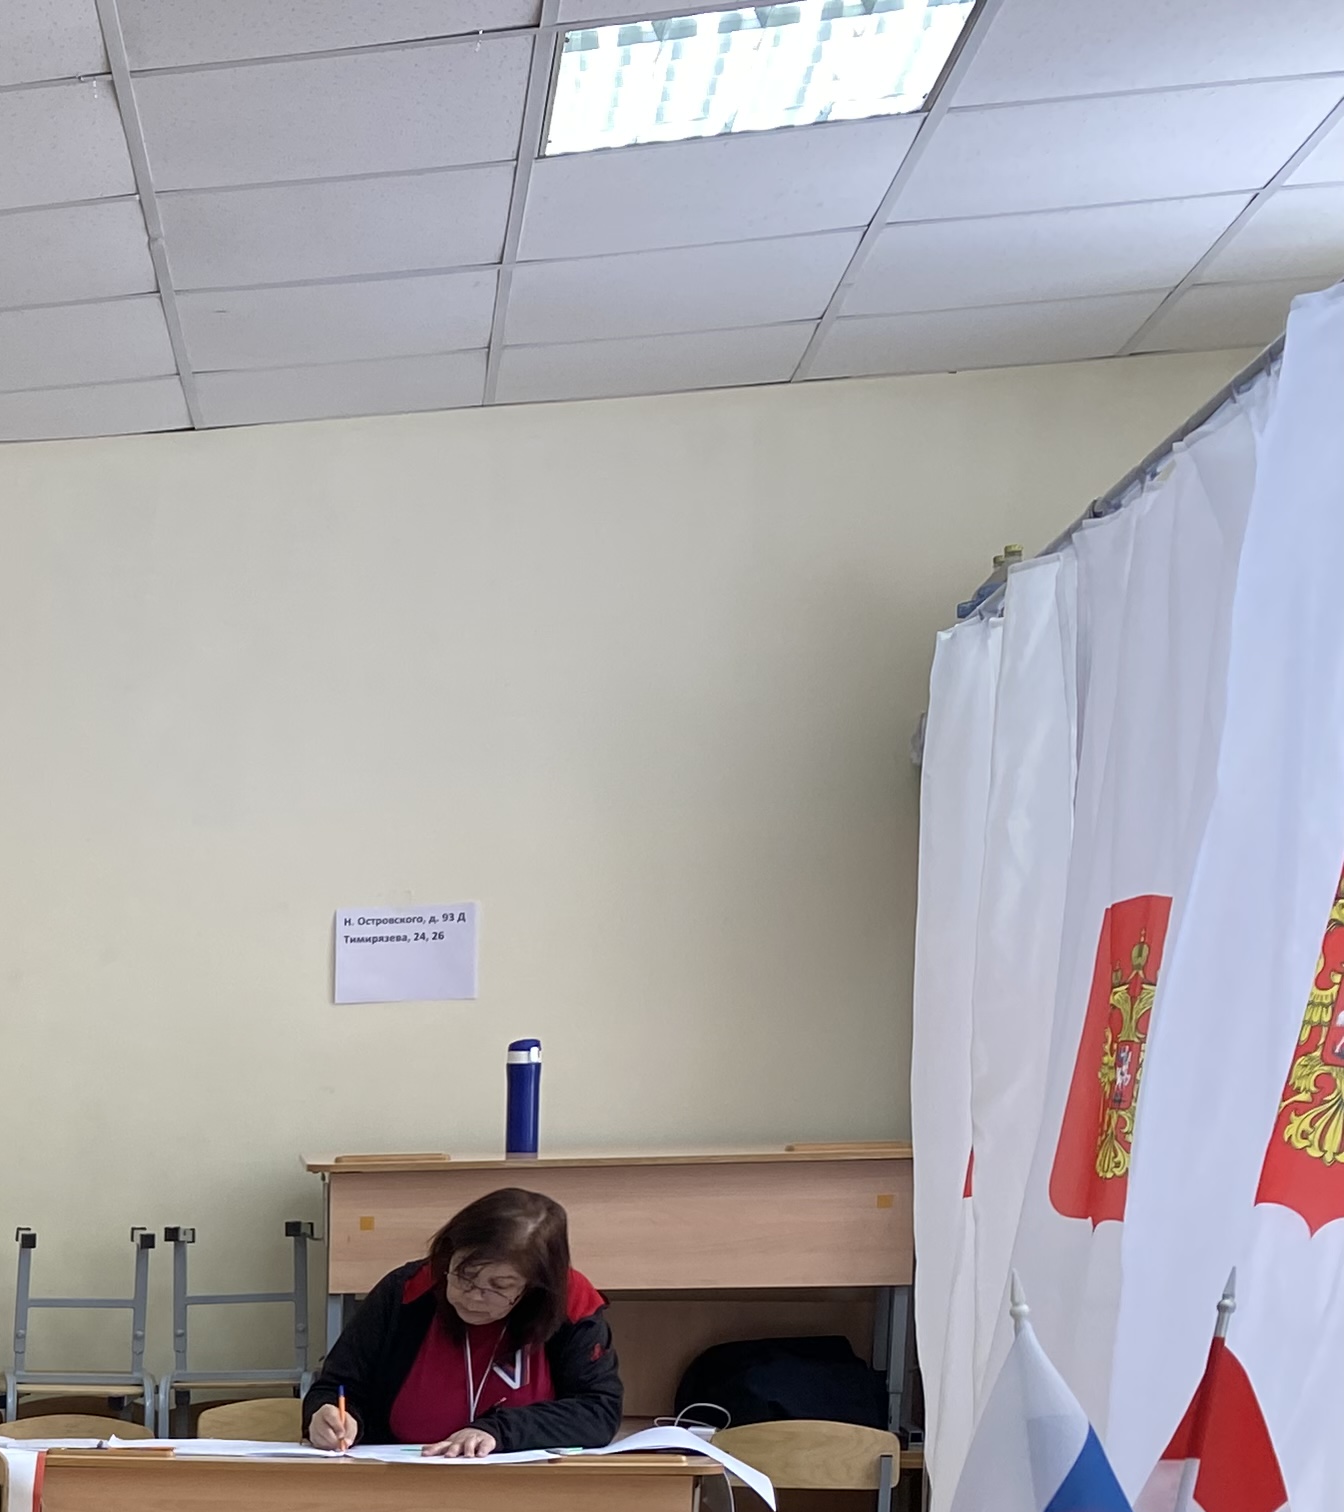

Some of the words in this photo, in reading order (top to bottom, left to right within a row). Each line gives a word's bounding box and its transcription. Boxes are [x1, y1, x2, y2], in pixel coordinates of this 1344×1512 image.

[357, 914, 426, 927] Островского,
[442, 912, 455, 922] 93
[344, 934, 411, 945] Тимирязева,
[413, 932, 429, 942] 24,
[431, 931, 445, 941] 26
